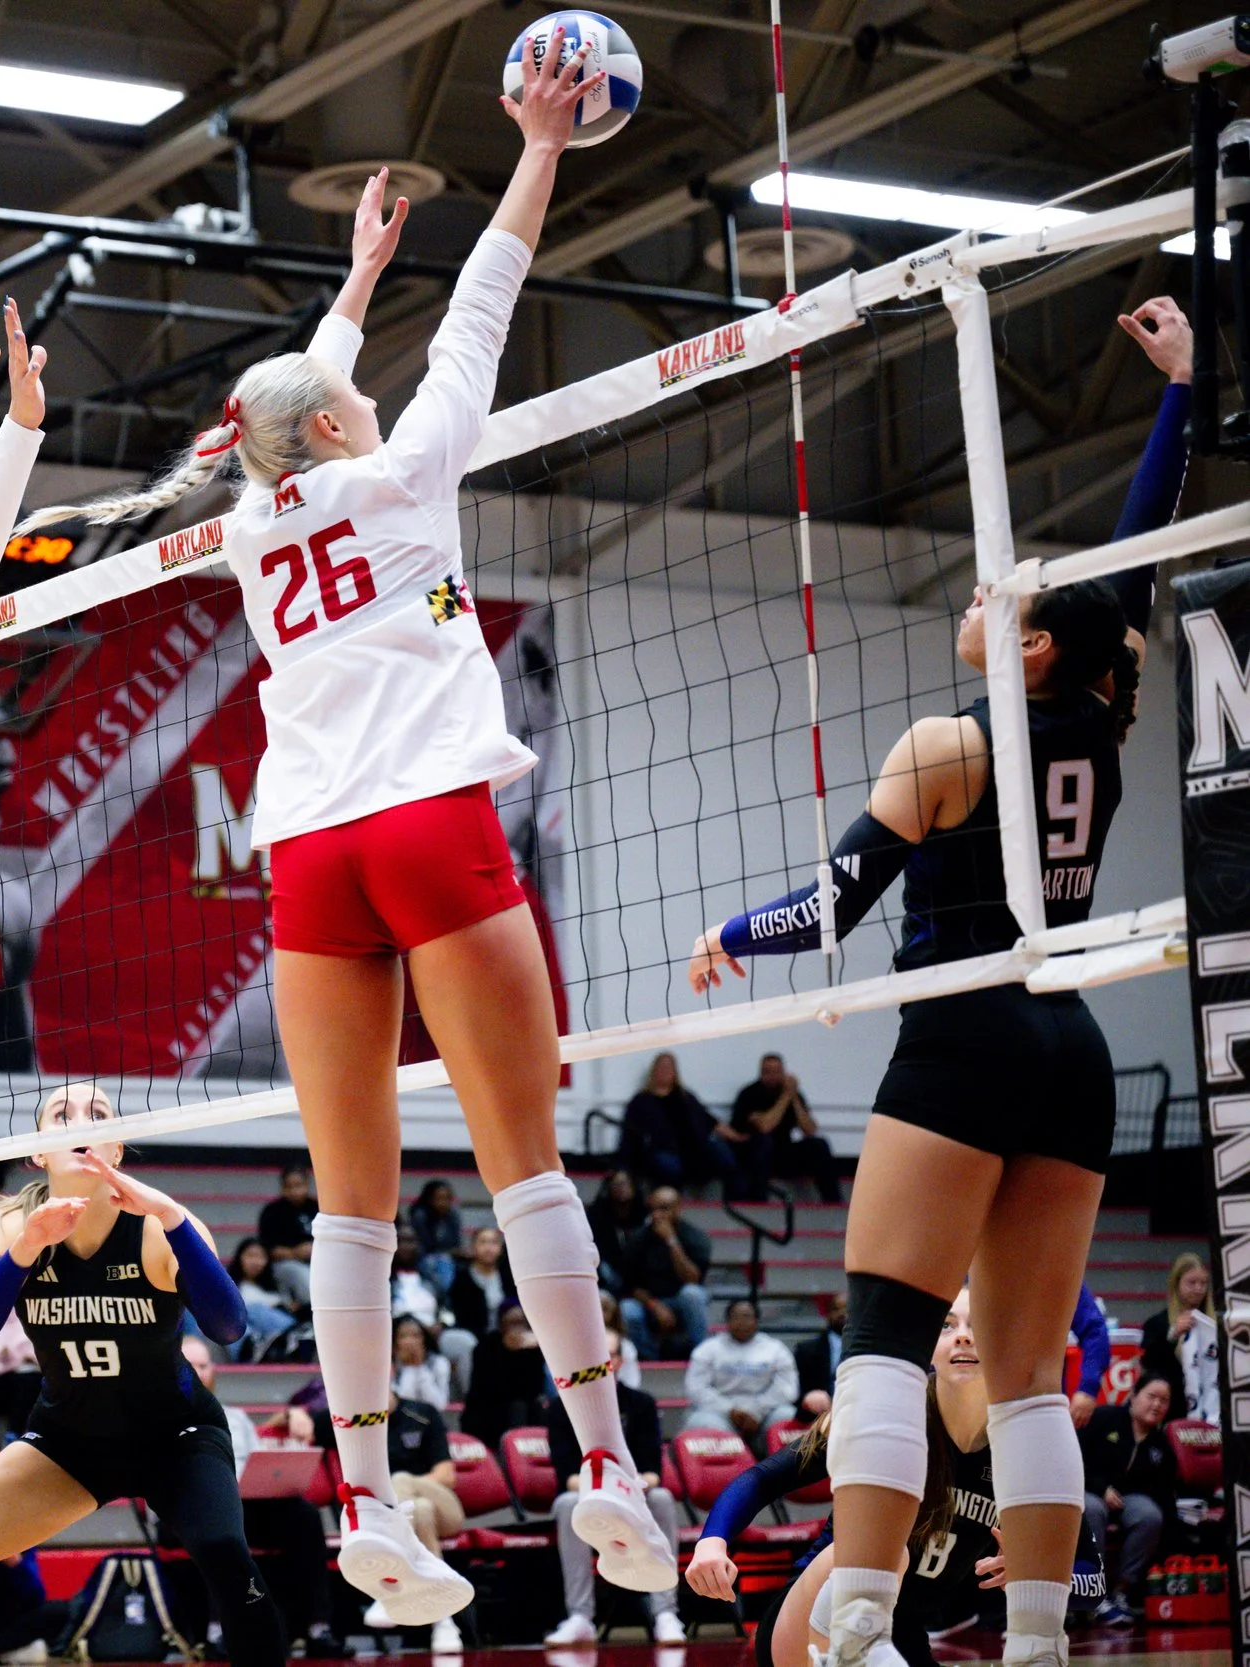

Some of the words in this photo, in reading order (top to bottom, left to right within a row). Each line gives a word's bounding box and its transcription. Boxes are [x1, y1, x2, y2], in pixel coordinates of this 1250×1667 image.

[917, 249, 950, 269] Senoh
[657, 323, 746, 382] MARYLAND
[158, 519, 224, 566] MARYLAND
[260, 519, 377, 645] 26
[1046, 758, 1095, 859] 9
[1041, 863, 1095, 901] ARTON
[25, 1296, 157, 1326] WASHINGTON
[60, 1340, 121, 1379] 19
